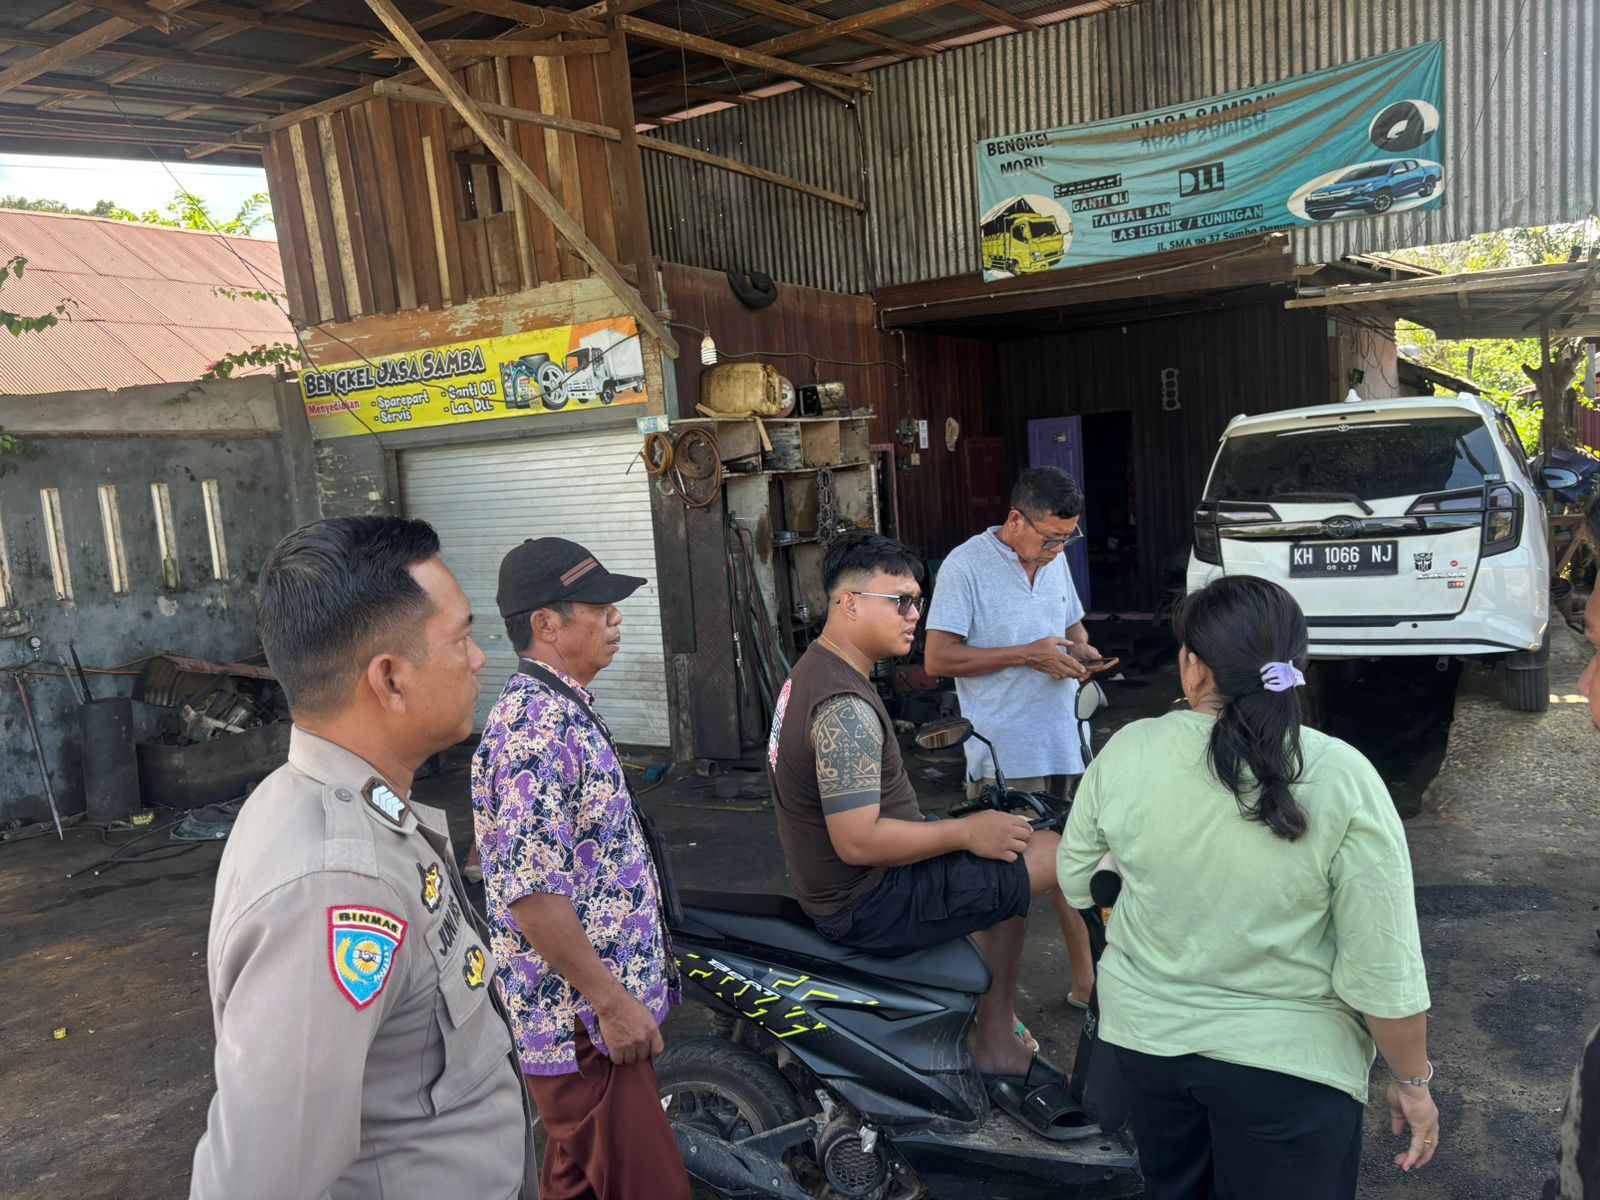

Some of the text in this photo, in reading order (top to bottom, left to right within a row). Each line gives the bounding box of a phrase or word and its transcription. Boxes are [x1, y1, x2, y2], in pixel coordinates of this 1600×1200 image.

[1179, 165, 1224, 196] DLL
[1072, 191, 1129, 212] GANTI OLI
[1093, 203, 1170, 227] TAMBAL BAN
[1112, 229, 1136, 243] LAS
[1139, 219, 1183, 238] LISTRIK
[1197, 206, 1262, 227] KUNINGAN
[1169, 238, 1193, 250] SMA
[1208, 233, 1220, 243] 37
[1223, 227, 1257, 240] Samba
[304, 346, 487, 398] BENGKEL JASA SAMBA
[377, 390, 430, 409] Sparepart
[380, 409, 412, 423] Servis
[1293, 544, 1393, 565] KH 1066 NJ
[338, 912, 399, 933] BINMAS
